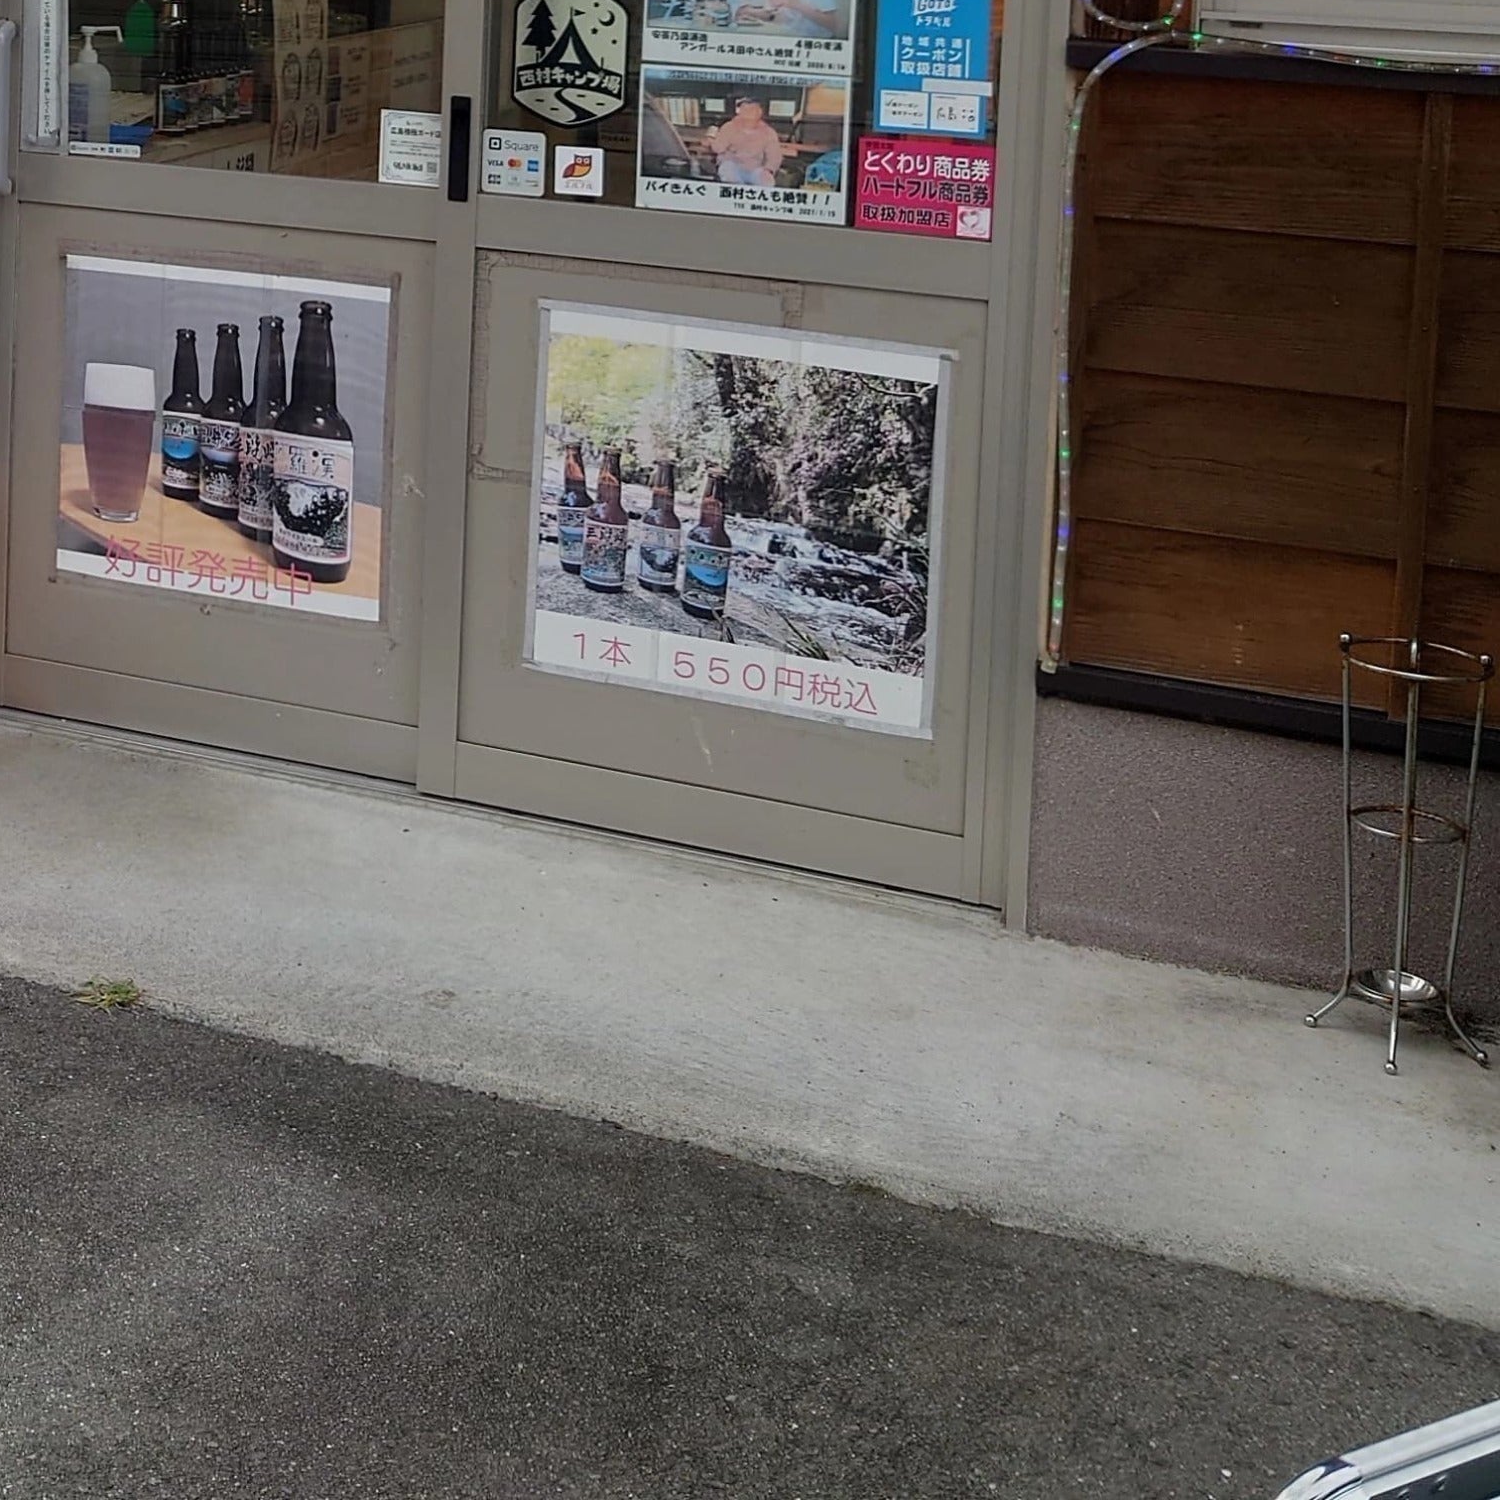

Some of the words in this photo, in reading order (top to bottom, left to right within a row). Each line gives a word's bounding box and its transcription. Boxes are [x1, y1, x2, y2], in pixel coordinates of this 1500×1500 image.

[901, 47, 962, 62] クーポン
[518, 66, 621, 94] 西村キャンプ場
[504, 139, 540, 152] Square
[864, 150, 990, 182] とくわり商品券
[863, 176, 989, 205] ハートフル商品券
[862, 204, 951, 229] 取扱加盟店
[104, 534, 314, 606] 好評発売中
[572, 632, 631, 668] 1本
[673, 650, 879, 717] 550円税込
